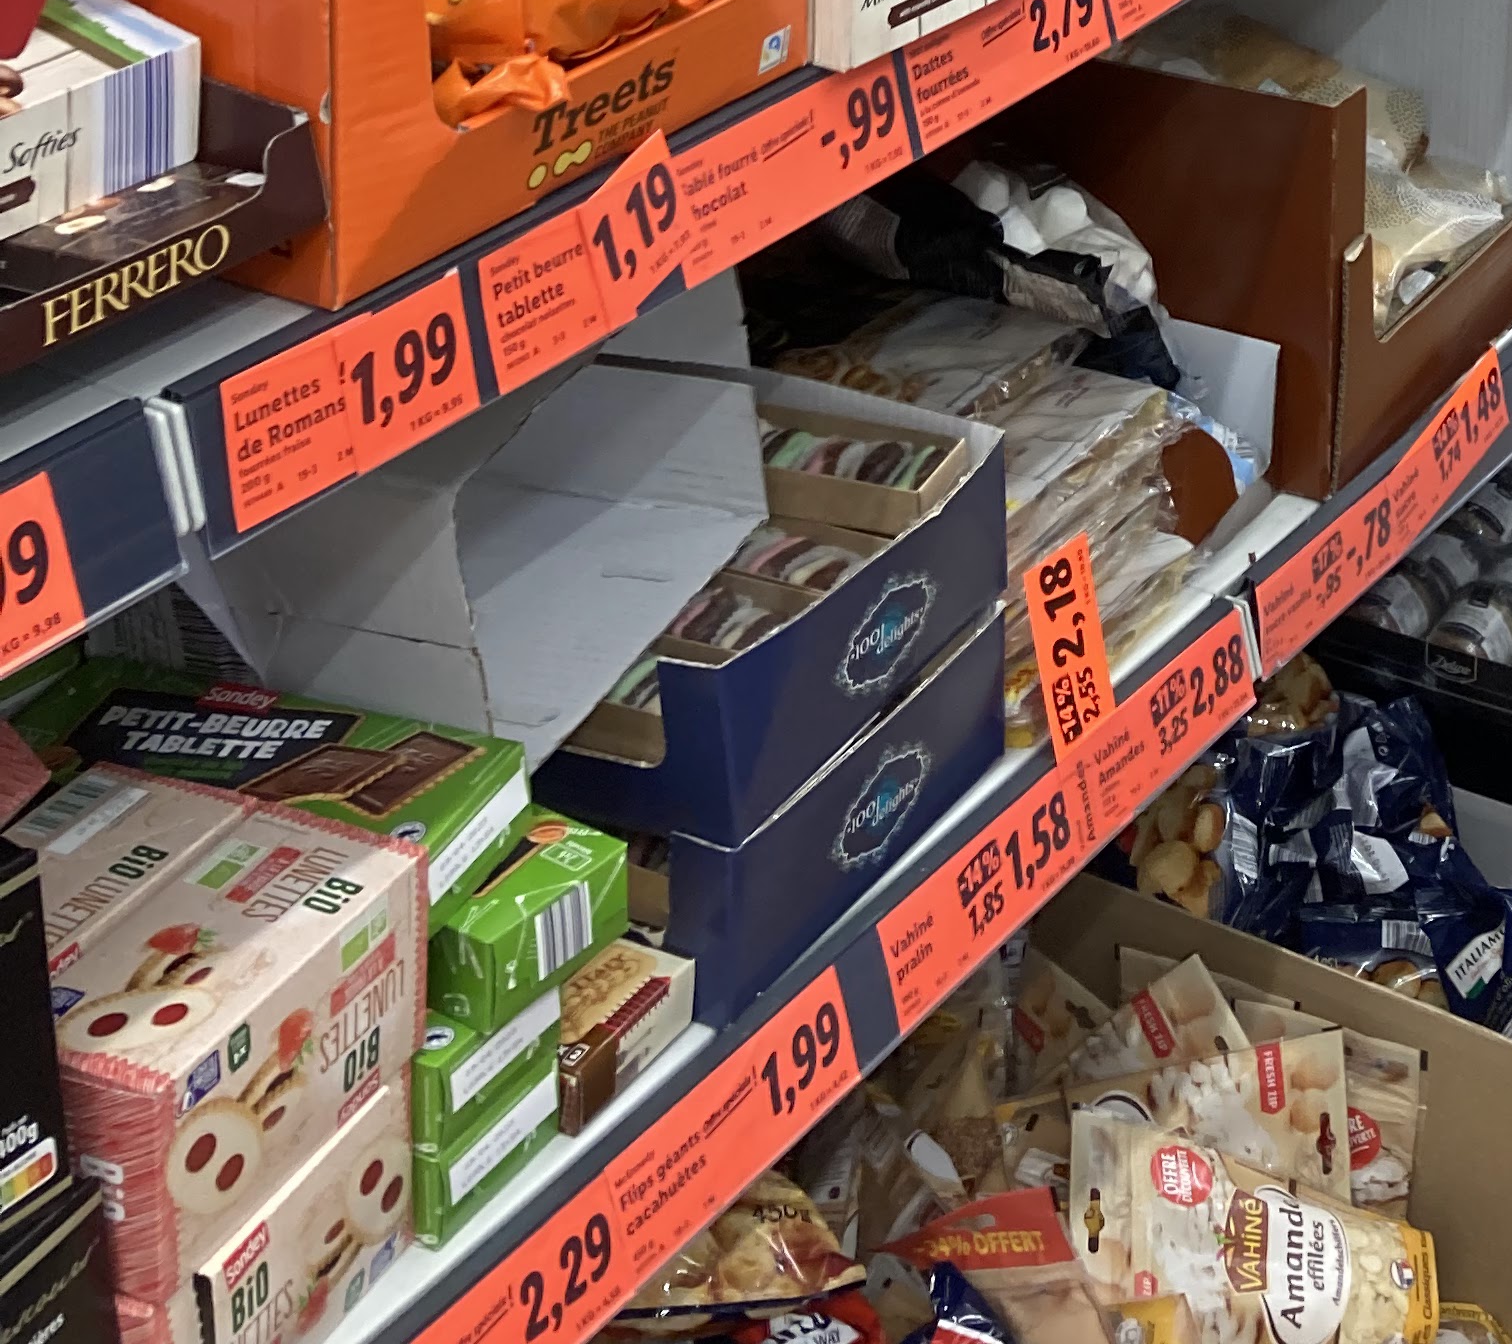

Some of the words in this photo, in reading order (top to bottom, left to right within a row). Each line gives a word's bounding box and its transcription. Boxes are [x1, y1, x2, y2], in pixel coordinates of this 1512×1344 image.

[912, 49, 954, 81] Dattes
[916, 65, 970, 105] fourrées
[532, 55, 678, 156] Treets
[820, 74, 896, 171] -,99
[3, 123, 83, 175] Softies
[591, 161, 678, 283] 1,19
[42, 222, 232, 349] FERRERO
[492, 270, 530, 303] Petit
[531, 242, 585, 280] beurre
[496, 279, 566, 330] tablette
[349, 309, 457, 430] 1,99
[233, 373, 321, 433] Lunettes
[236, 436, 264, 463] de
[266, 394, 346, 449] Romans
[1461, 366, 1502, 445] 1,48
[1038, 556, 1087, 669] 2,18
[203, 686, 277, 709] Sondey
[1189, 632, 1245, 718] 2,88
[100, 707, 334, 740] PETIT-BEURRE
[121, 730, 281, 761] TABLETTE
[1093, 726, 1131, 766] Vahiné
[1098, 739, 1146, 786] Amandes
[1005, 789, 1070, 892] 1,58
[888, 911, 935, 959] Vahiné
[895, 940, 934, 984] pralin
[760, 1001, 841, 1118] 1,99
[618, 1173, 655, 1213] Flips
[655, 1131, 702, 1185] géants
[626, 1154, 707, 1237] cacahuètes
[1161, 1152, 1178, 1200] OFFRE
[225, 1223, 269, 1287] Sondey
[974, 1231, 1043, 1256] OFFERT
[1312, 1218, 1327, 1293] effilées
[518, 1211, 612, 1343] 2,29
